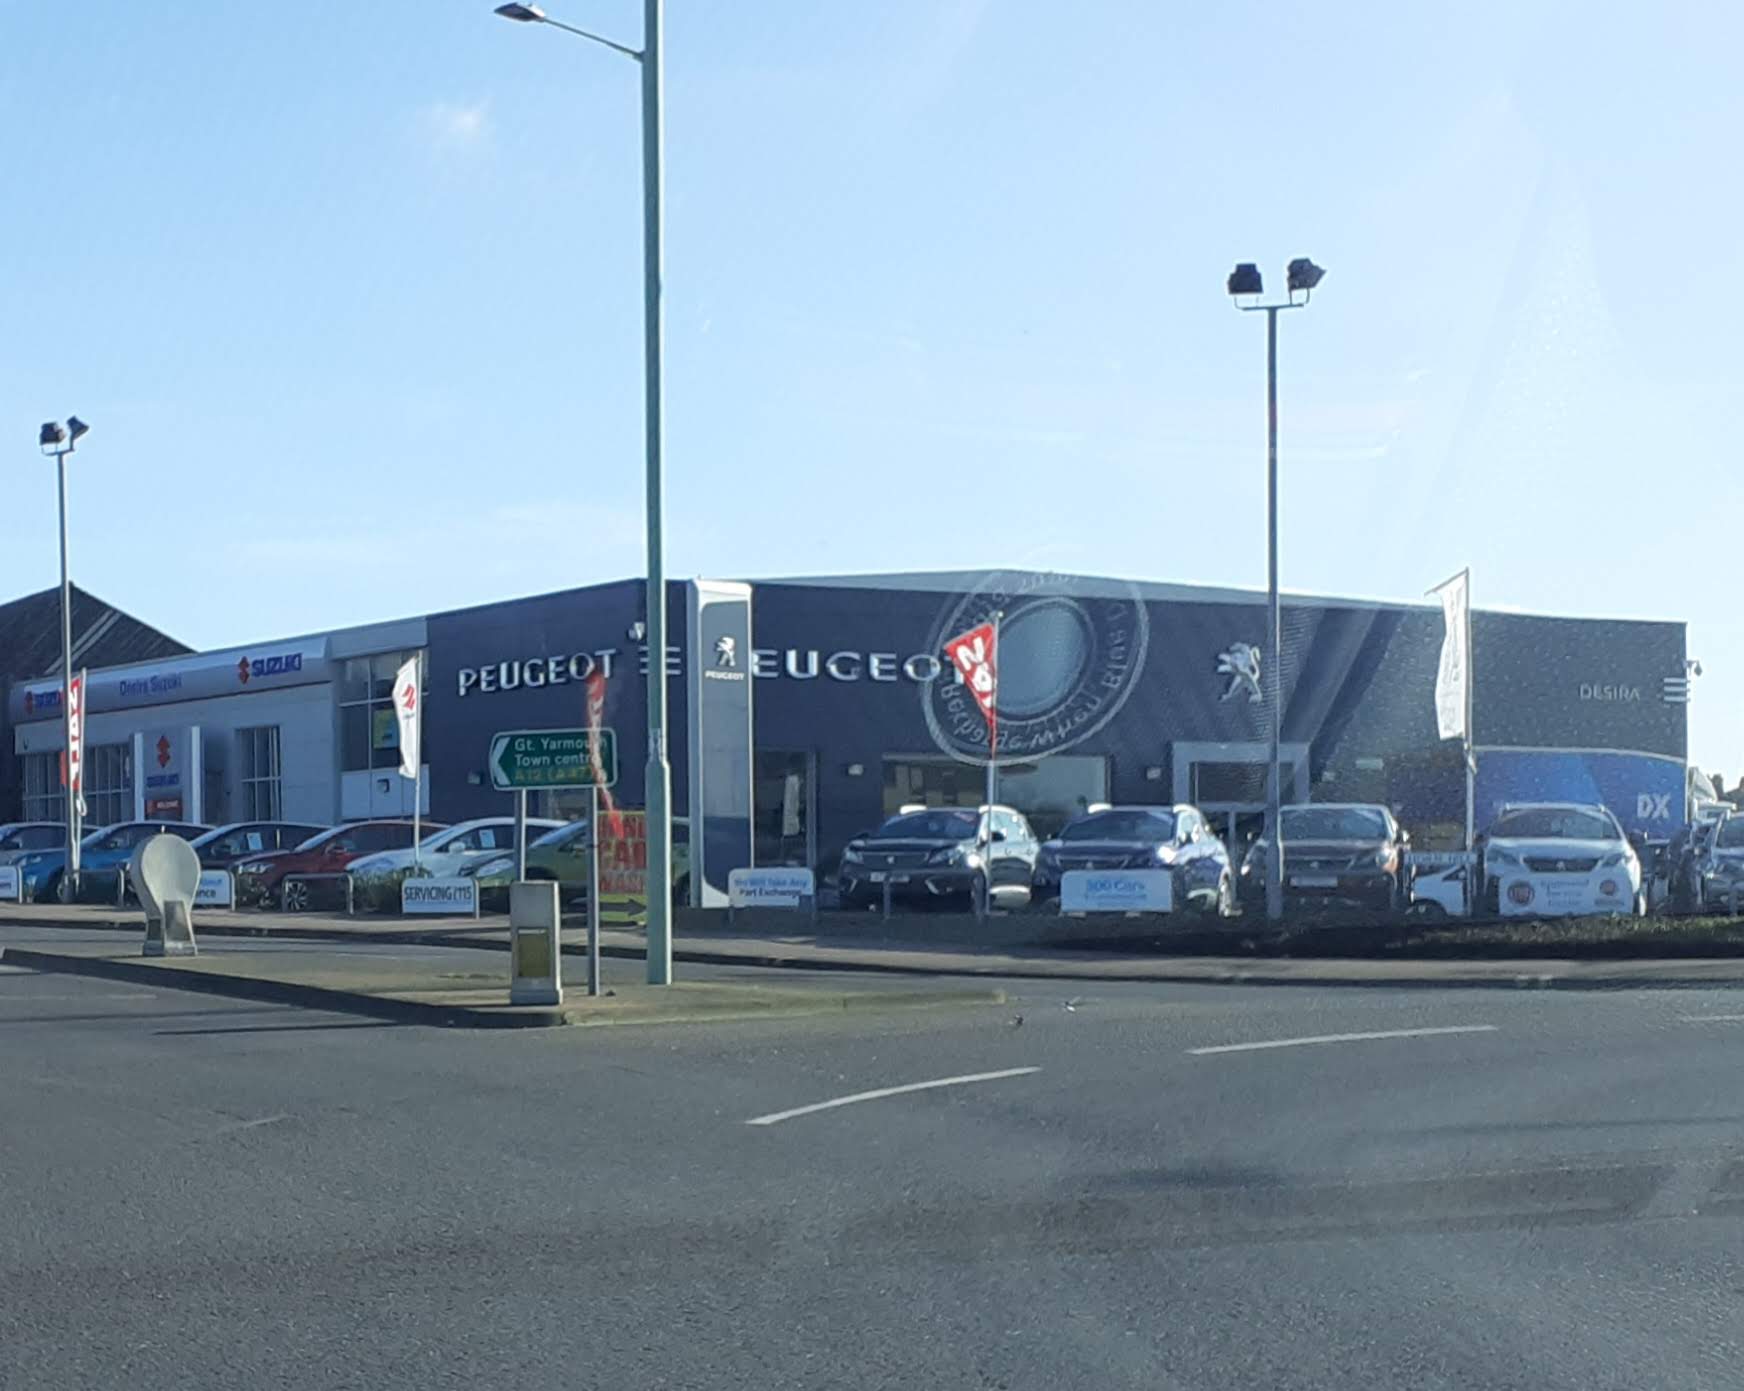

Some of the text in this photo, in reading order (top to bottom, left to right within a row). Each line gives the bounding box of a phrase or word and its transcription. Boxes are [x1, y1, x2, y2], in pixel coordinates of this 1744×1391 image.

[251, 652, 303, 678] SUZUKI
[458, 648, 617, 697] PEUGEOT
[750, 648, 964, 685] EUGEO
[704, 670, 745, 681] PEUGEOT
[540, 737, 608, 751] Yarmouh
[514, 752, 597, 767] Town centr
[1637, 792, 1672, 819] DX
[404, 886, 452, 900] SERVICING
